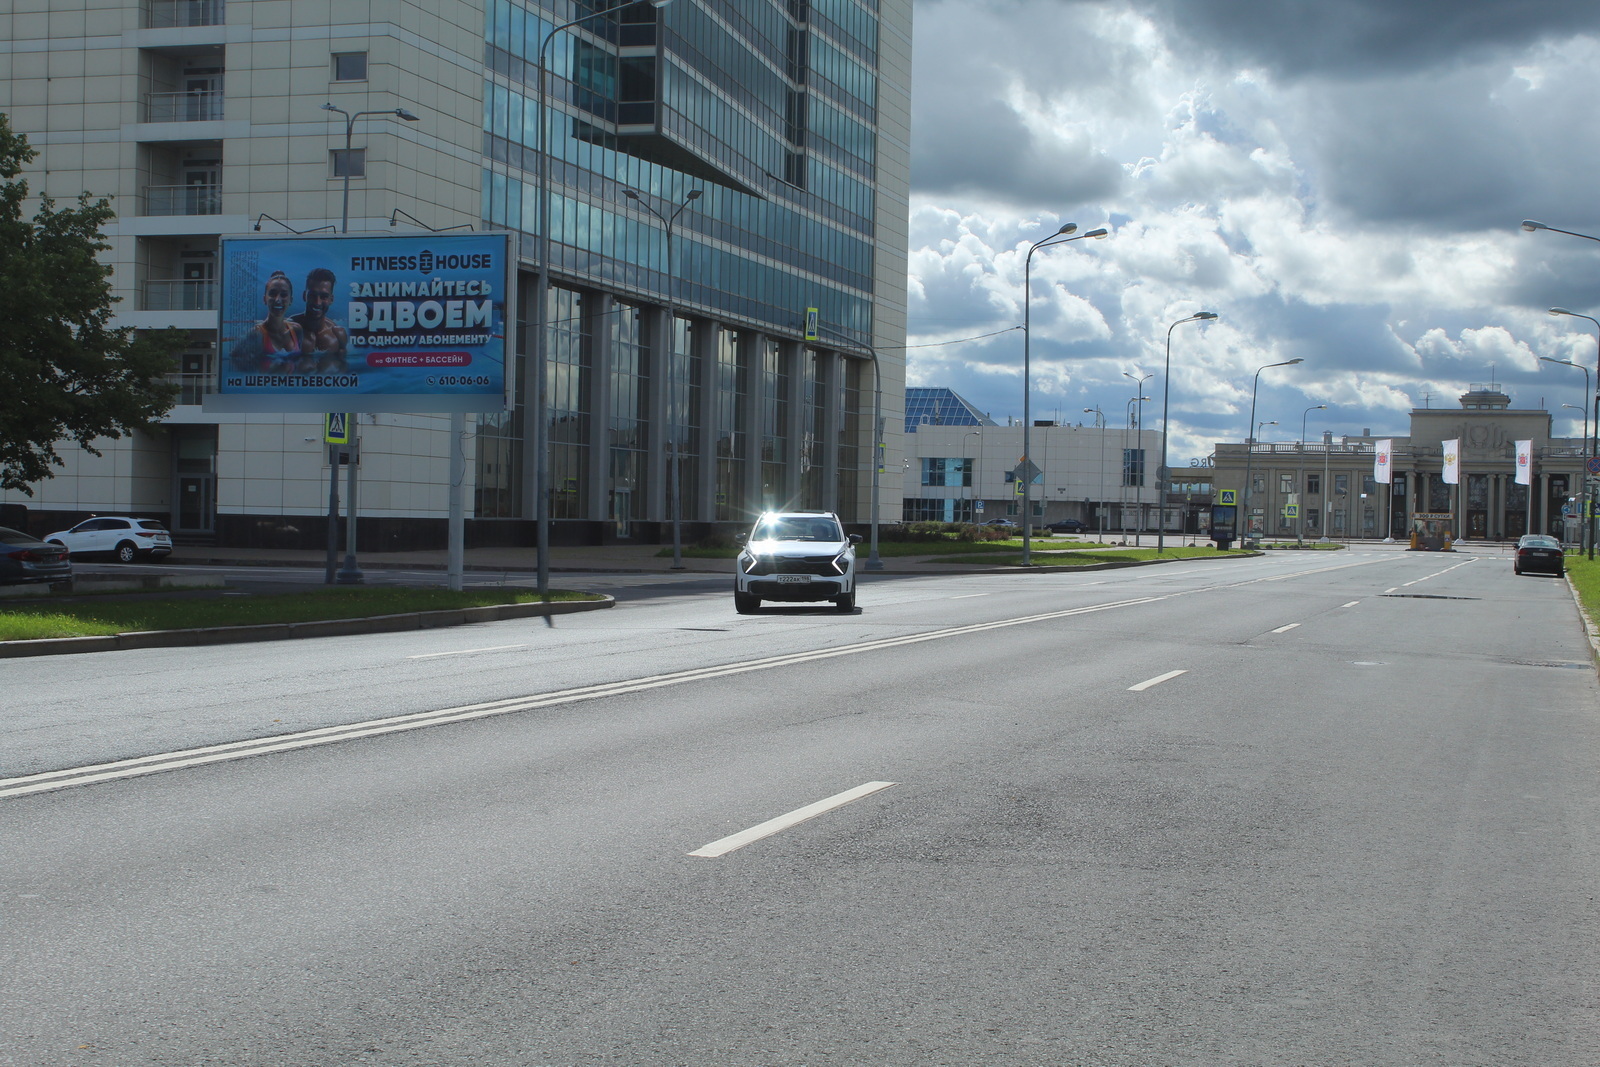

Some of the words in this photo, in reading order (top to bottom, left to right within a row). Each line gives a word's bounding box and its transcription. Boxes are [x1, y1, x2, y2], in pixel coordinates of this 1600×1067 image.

[351, 255, 417, 271] FITNESS
[435, 254, 491, 270] HOUSE
[348, 277, 492, 298] ЗАНИМАЙТЕСЬ
[348, 299, 493, 332] ВДВОЕМ
[349, 335, 366, 345] ПО
[368, 335, 417, 347] ОДНОМУ
[385, 356, 418, 364] ФИТНЕС
[425, 355, 463, 364] БАССЕЙН
[227, 378, 242, 387] на
[245, 374, 358, 388] ШЕРЕМЕТЬЕВСКОЙ
